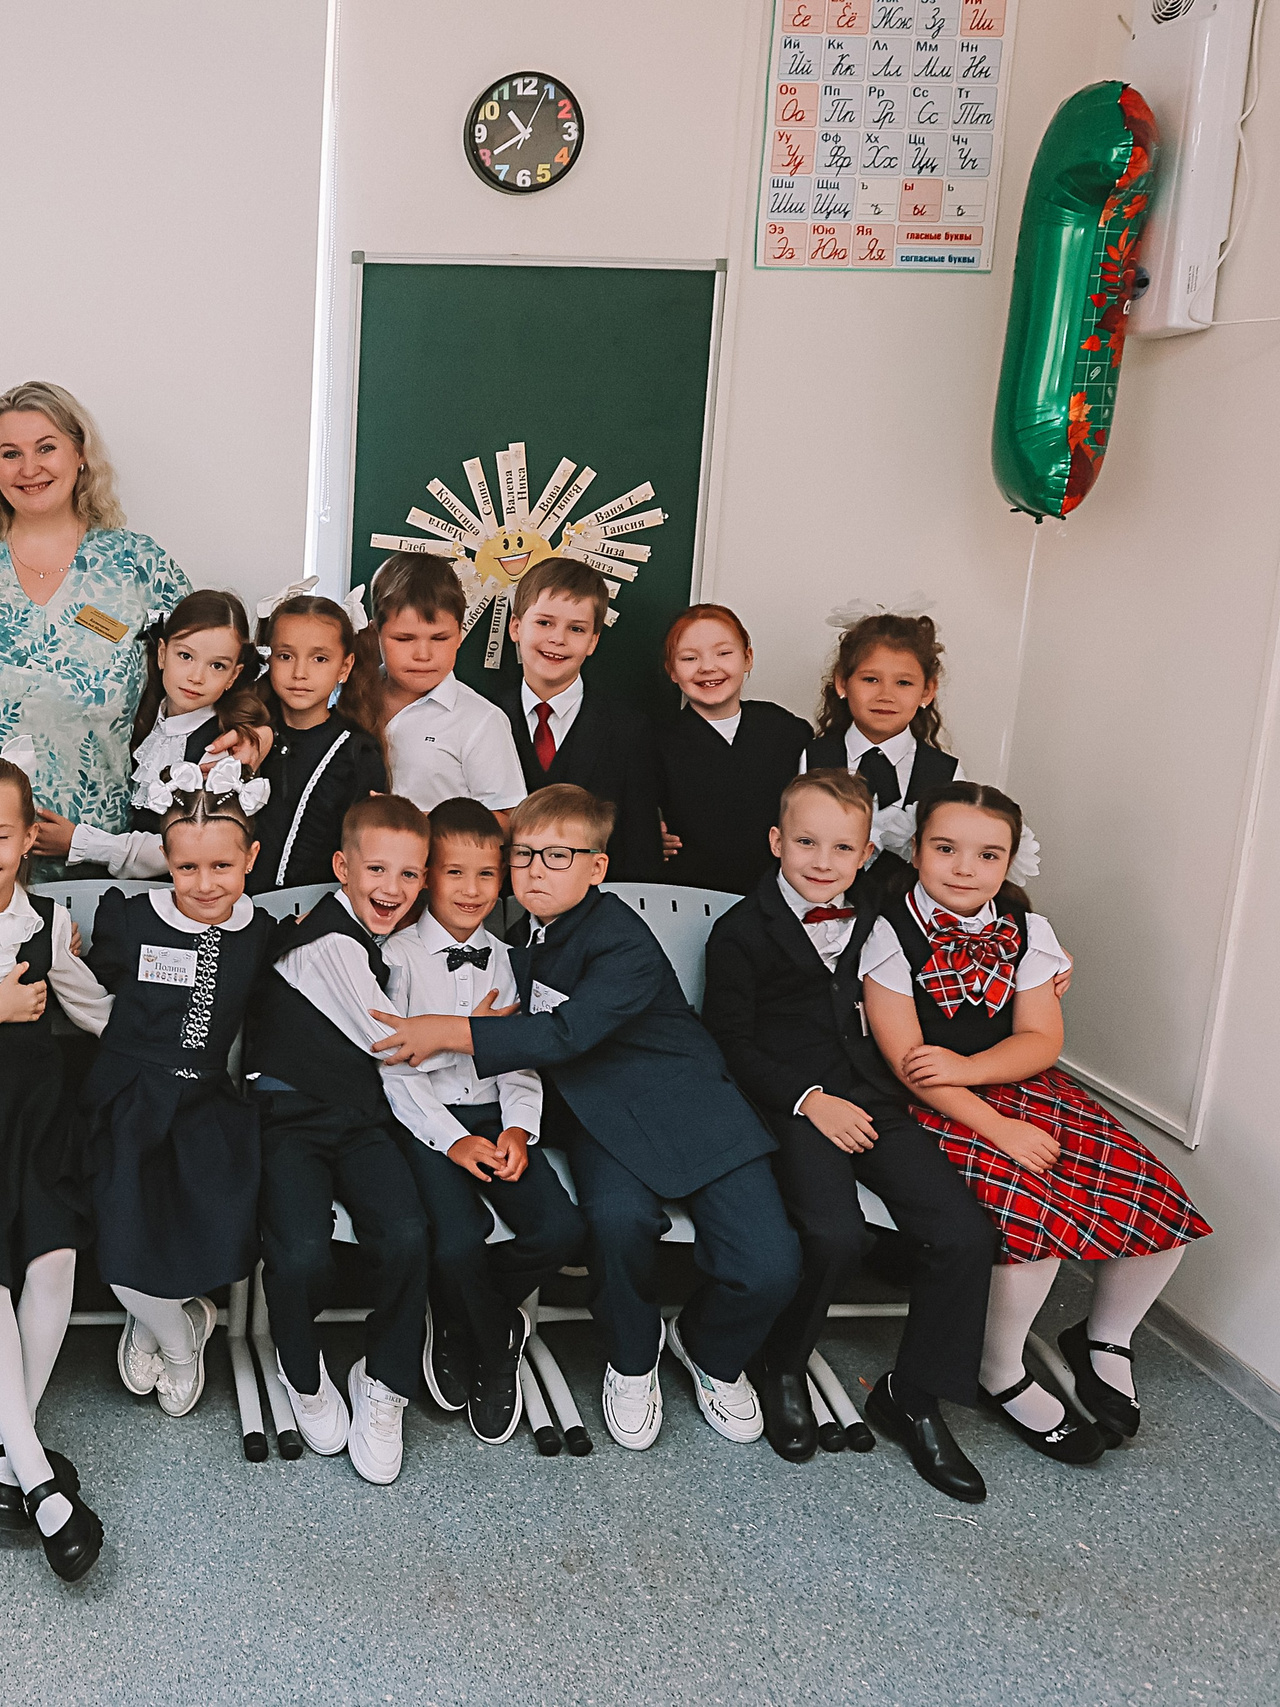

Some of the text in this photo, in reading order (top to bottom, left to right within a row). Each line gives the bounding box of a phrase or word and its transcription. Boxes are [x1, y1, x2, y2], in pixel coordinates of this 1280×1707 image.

[783, 36, 978, 52] Йй Кк Лл Мм Нн
[492, 82, 510, 100] 11
[512, 76, 538, 96] 12
[544, 83, 555, 100] 1
[780, 84, 971, 99] Оо Пп Рр Сс Тт
[478, 101, 500, 121] 10
[557, 99, 573, 119] 2
[474, 124, 488, 144] 9
[562, 122, 579, 141] 3
[778, 131, 968, 145] Уу Фф Хх Цц Чч
[554, 146, 570, 166] 4
[494, 164, 510, 181] 7
[516, 169, 532, 188] 6
[536, 163, 551, 182] 5
[772, 179, 794, 189] Шш
[816, 179, 840, 190] Щщ
[768, 224, 873, 236] Ээ Юю Яя
[906, 232, 972, 241] гласные буквы
[948, 254, 975, 264] буквы
[505, 470, 516, 514] Валера
[517, 467, 527, 500] Ника
[477, 480, 493, 516] Саша
[538, 484, 561, 512] Вова
[548, 483, 583, 523] Ваня Г.
[436, 488, 480, 536] Кристина
[594, 495, 638, 523] Ваня Т.
[428, 516, 466, 542] Марта
[600, 520, 645, 536] Таисия
[398, 539, 426, 553] Глеб
[595, 542, 625, 557] Лиза
[583, 554, 614, 573] Злата
[461, 595, 490, 633] Роберт
[486, 595, 507, 662] Миша Ов.
[155, 962, 187, 974] Полина
